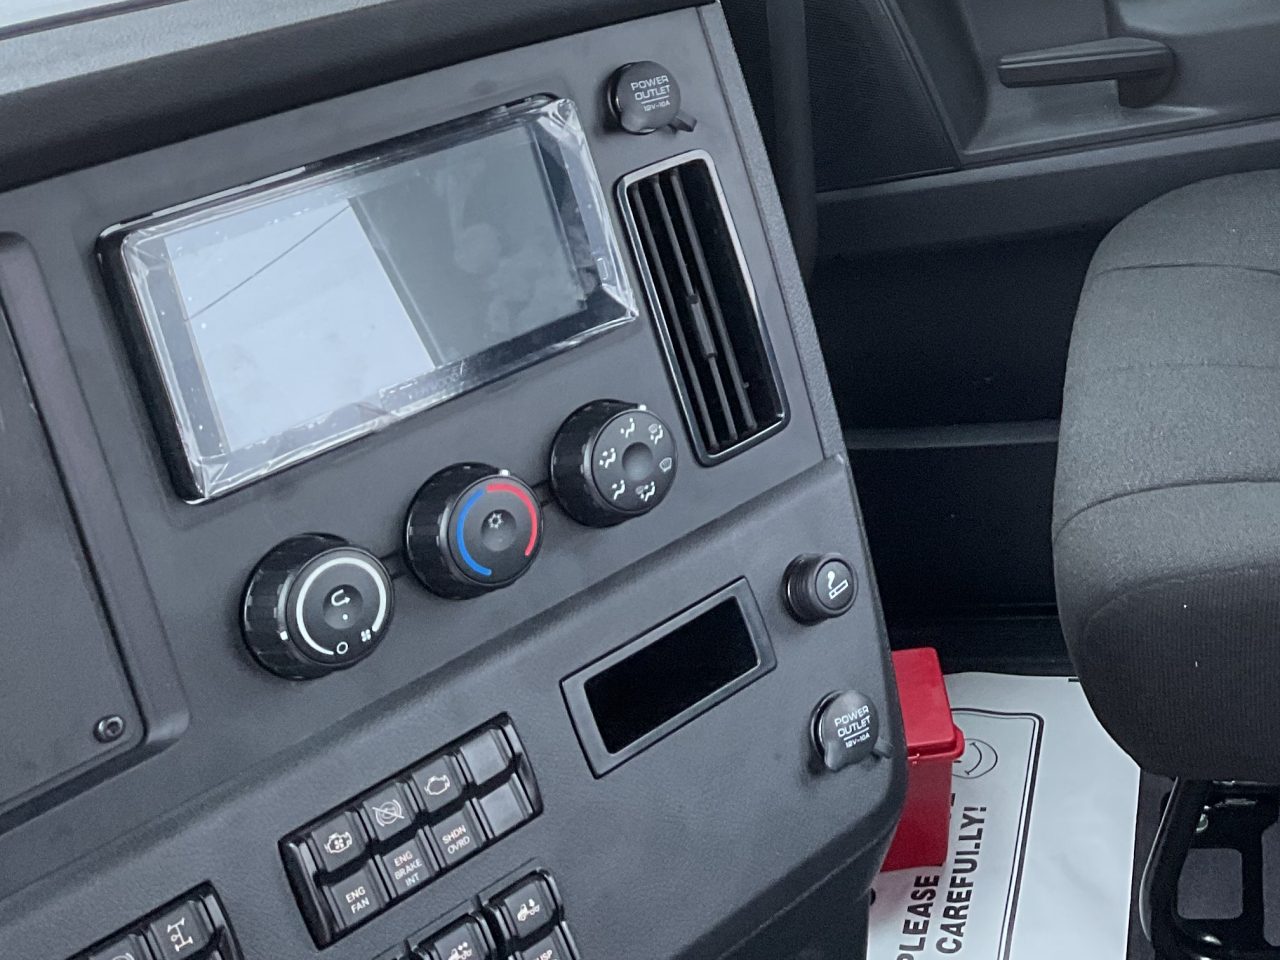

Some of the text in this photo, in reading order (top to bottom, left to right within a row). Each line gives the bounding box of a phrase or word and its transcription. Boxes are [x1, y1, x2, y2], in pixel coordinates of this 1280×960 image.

[631, 75, 669, 90] POWER
[634, 85, 670, 100] OUTLET
[834, 704, 870, 727] POWER
[837, 715, 871, 738] OUTLET
[442, 824, 467, 844] SHDN
[447, 836, 470, 854] OVRD
[393, 850, 414, 867] ENG
[394, 858, 423, 880] BRAKE
[405, 872, 419, 887] INT
[935, 806, 987, 954] CAREFULLY!
[345, 886, 366, 903] ENG
[350, 897, 370, 914] FAN
